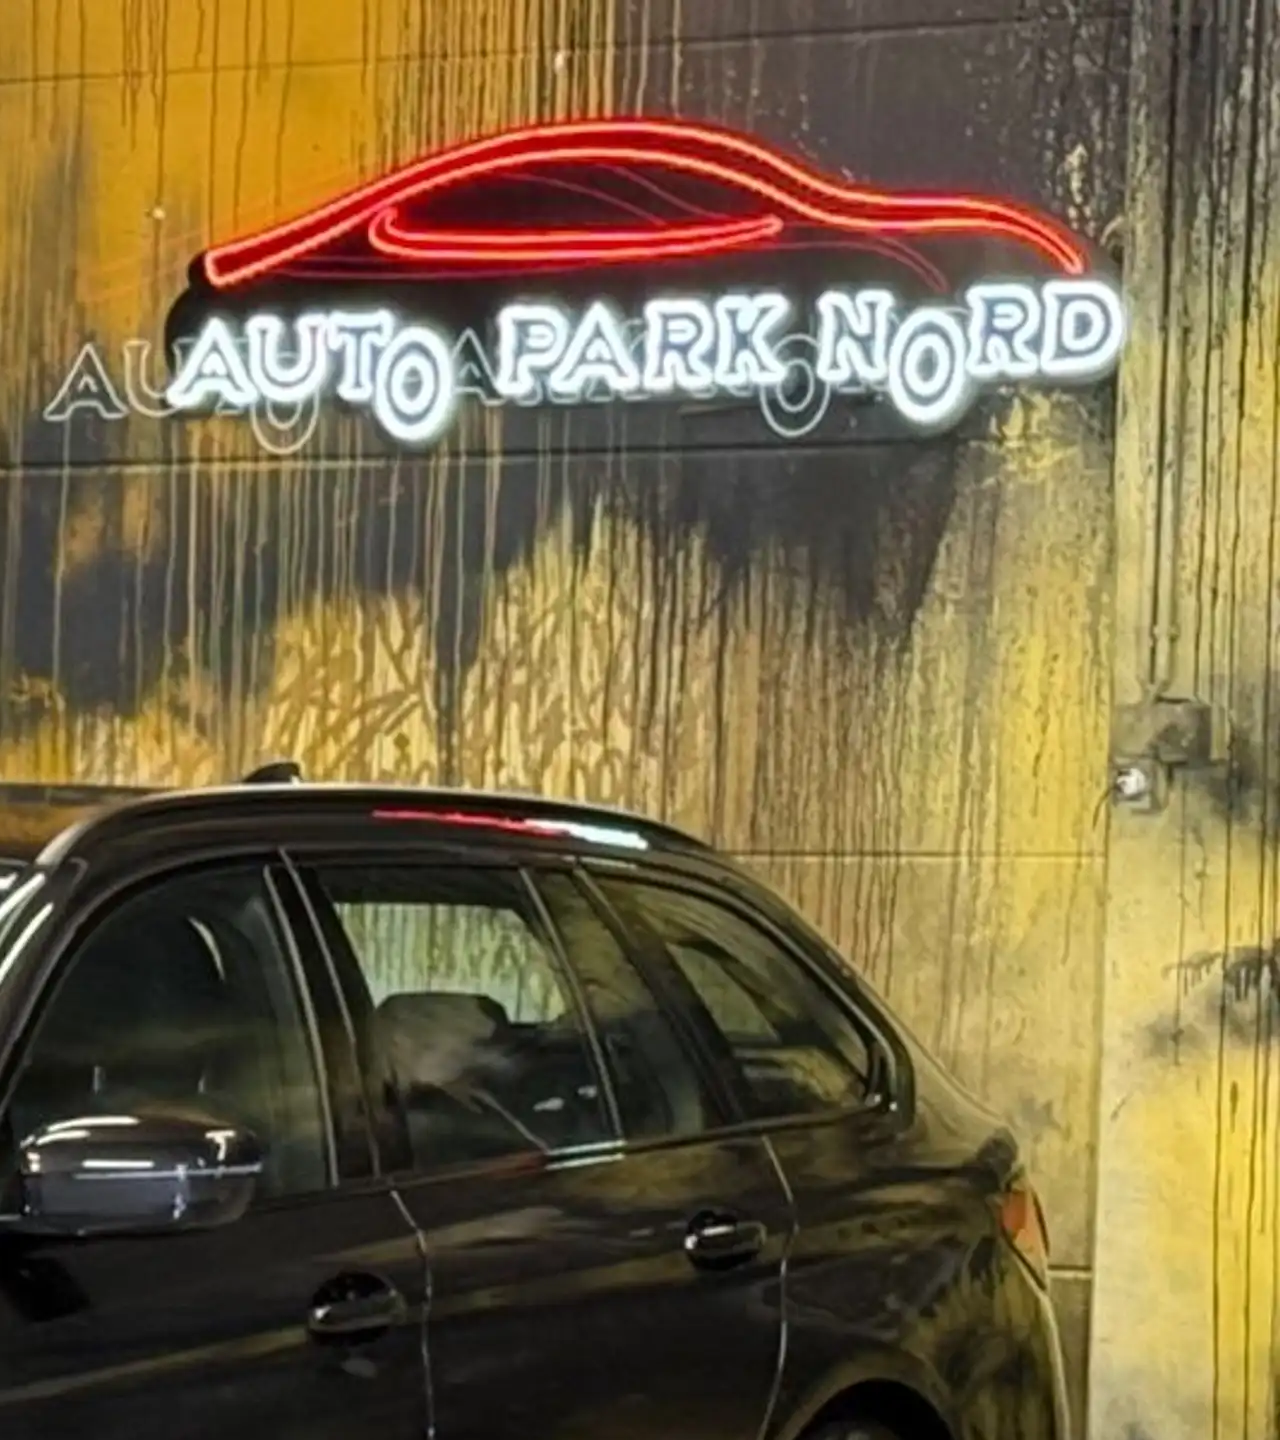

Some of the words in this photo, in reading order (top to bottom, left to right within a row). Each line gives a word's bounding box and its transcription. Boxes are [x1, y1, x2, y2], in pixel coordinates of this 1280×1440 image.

[166, 309, 452, 444] AUTO
[496, 293, 787, 396] PARK
[816, 278, 1124, 424] NORD
